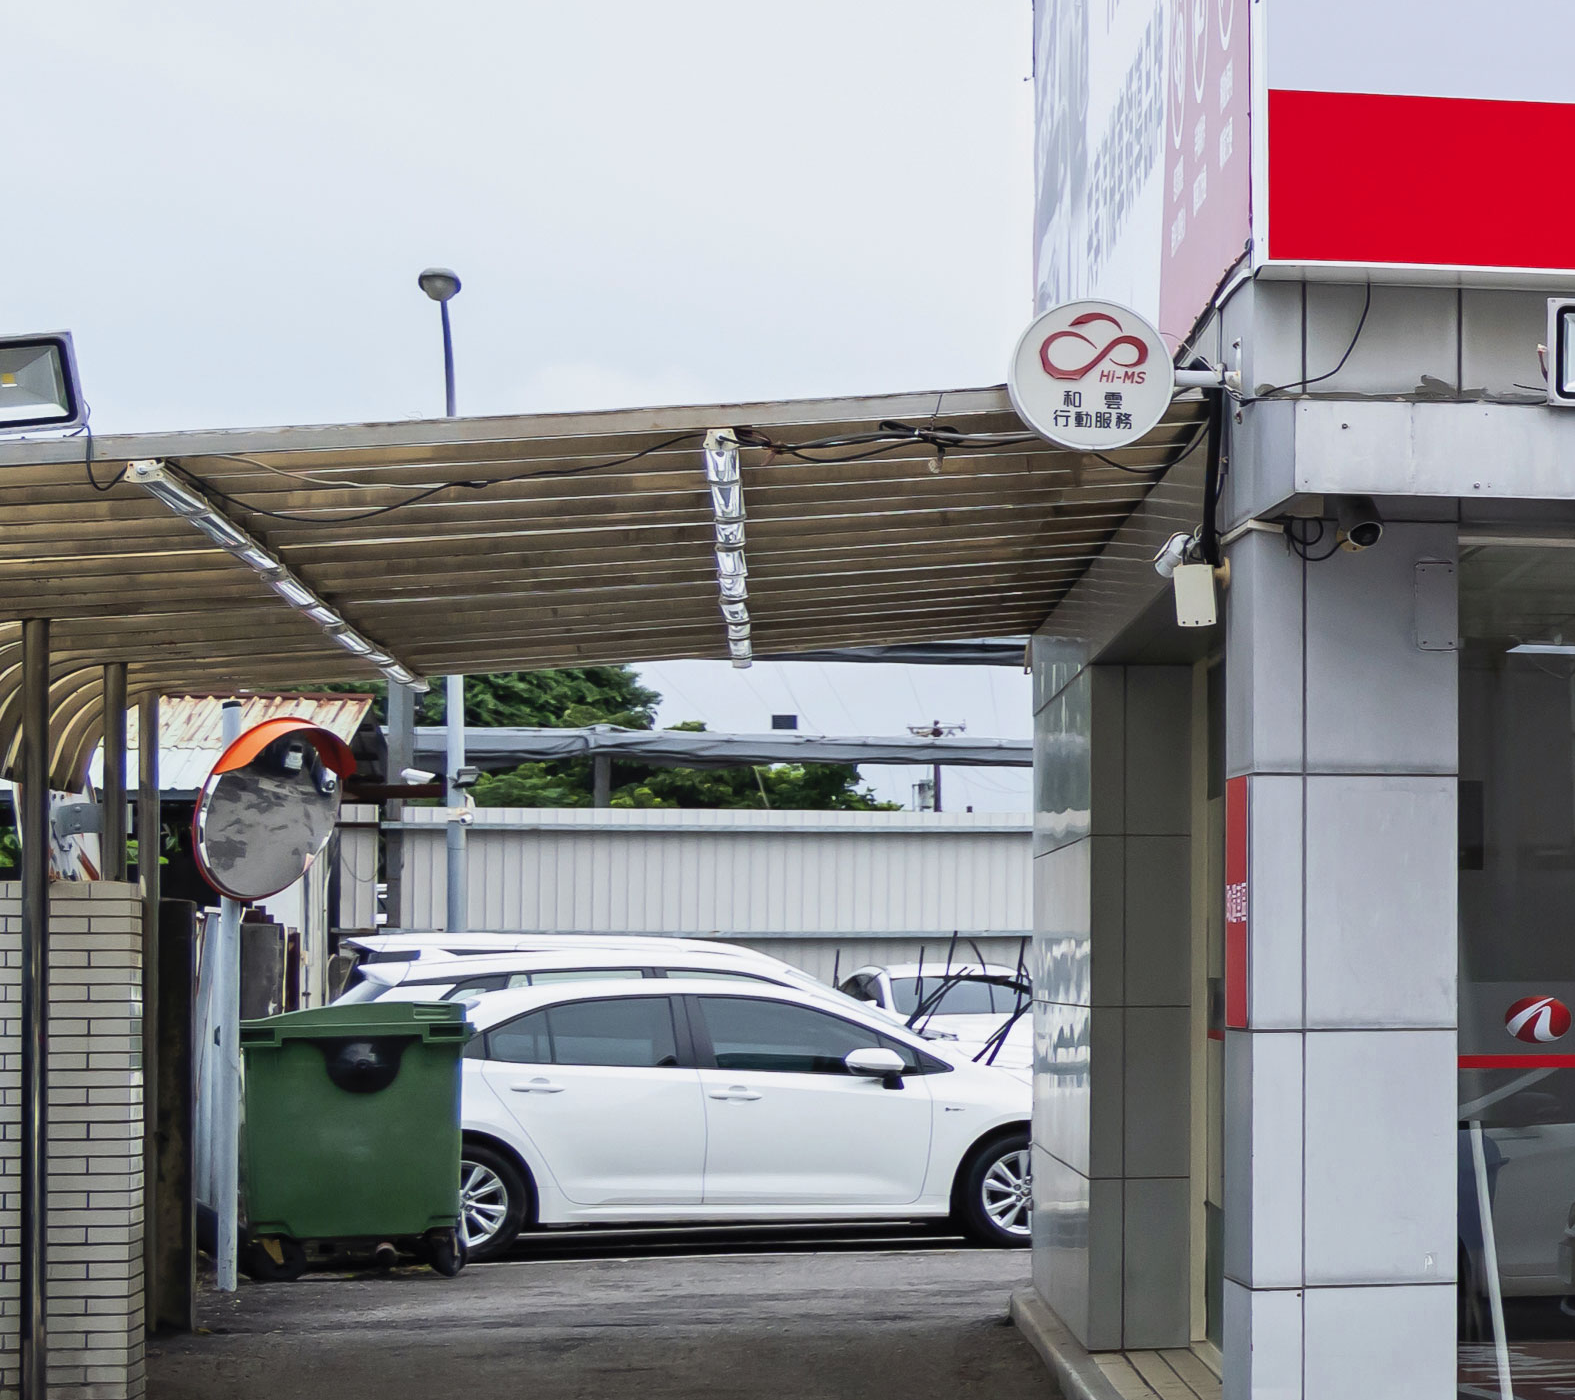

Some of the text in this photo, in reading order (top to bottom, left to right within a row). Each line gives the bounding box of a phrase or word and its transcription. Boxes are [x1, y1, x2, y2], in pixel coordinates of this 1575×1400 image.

[1099, 370, 1147, 384] Hi-MS
[1063, 390, 1123, 410] 和雲
[1053, 409, 1132, 430] 行動服務
